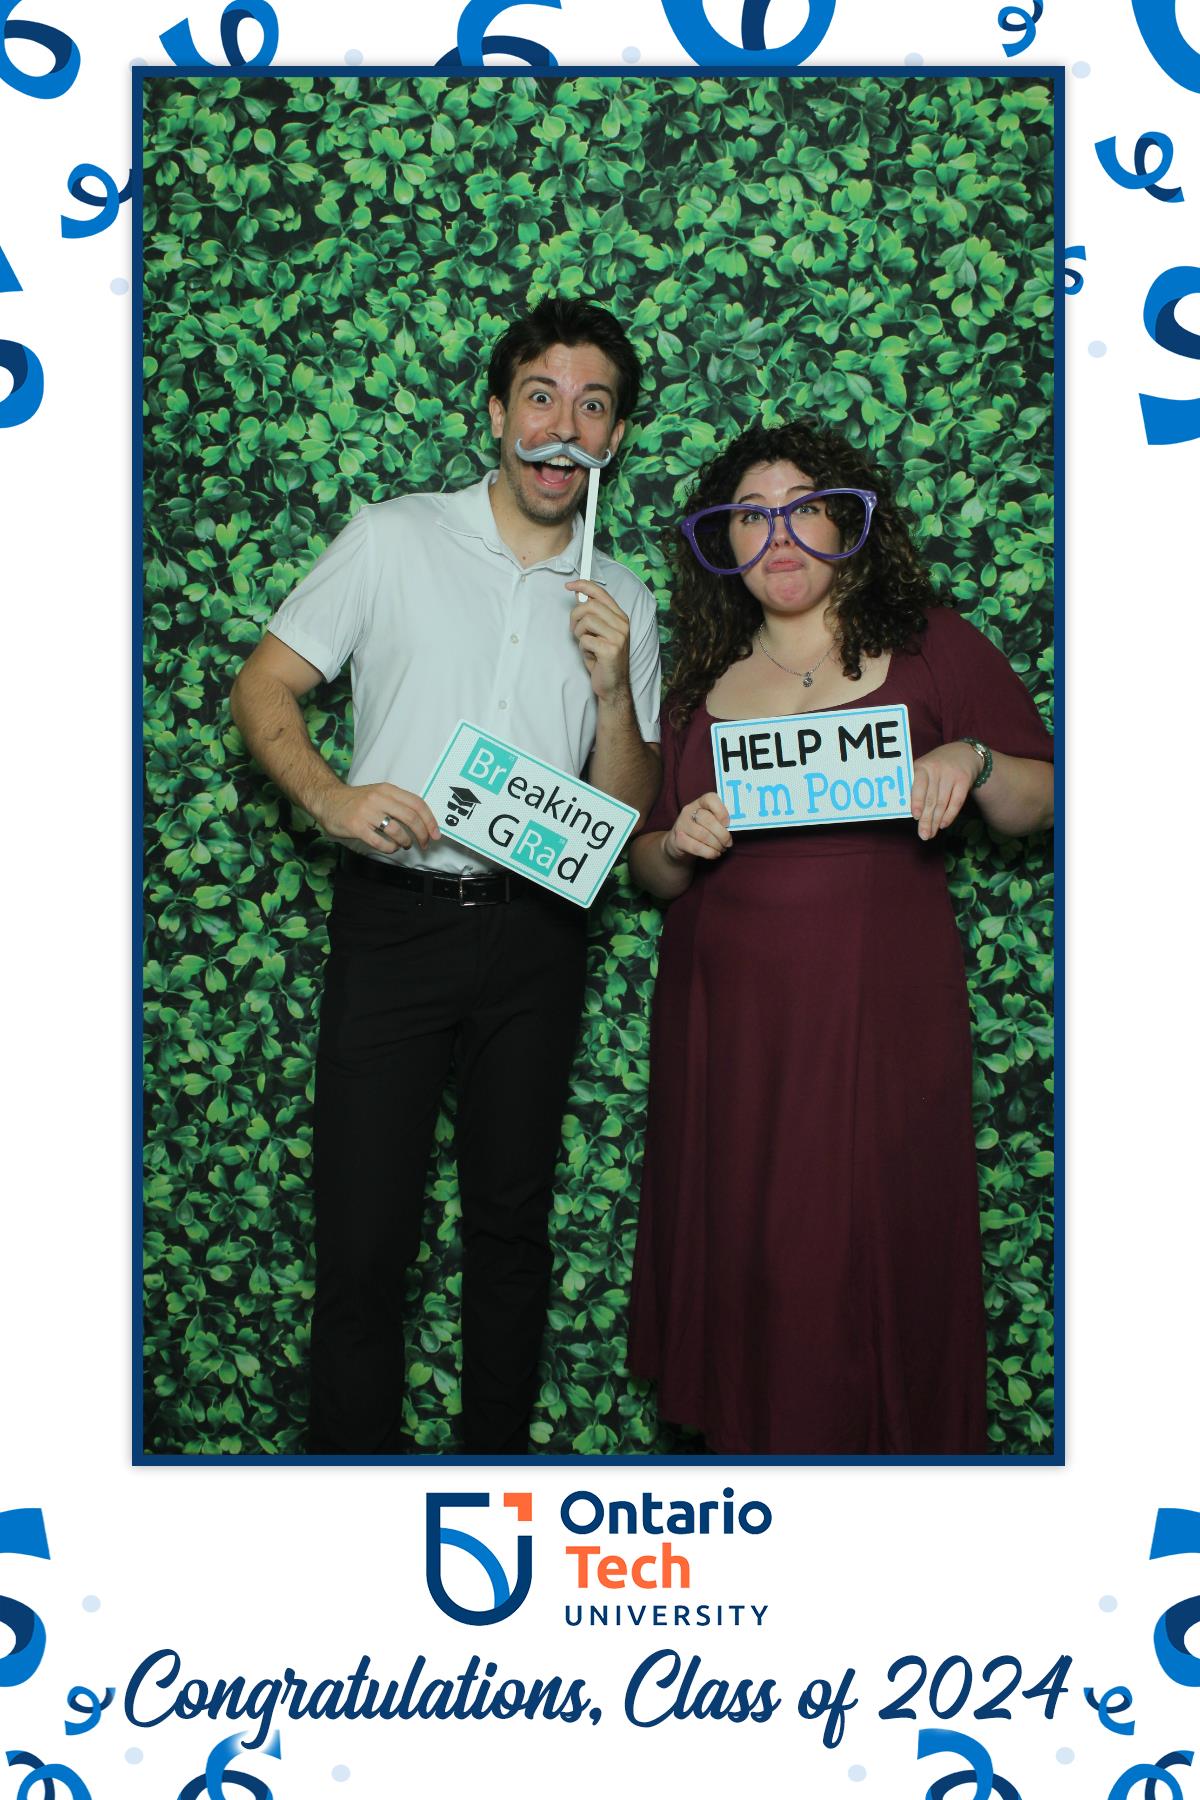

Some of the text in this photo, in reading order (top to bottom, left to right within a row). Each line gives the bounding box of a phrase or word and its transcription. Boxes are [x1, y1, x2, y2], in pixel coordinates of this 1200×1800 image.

[720, 720, 901, 773] HELP ME
[467, 747, 615, 850] Breaking
[726, 766, 907, 819] I'm Poor!
